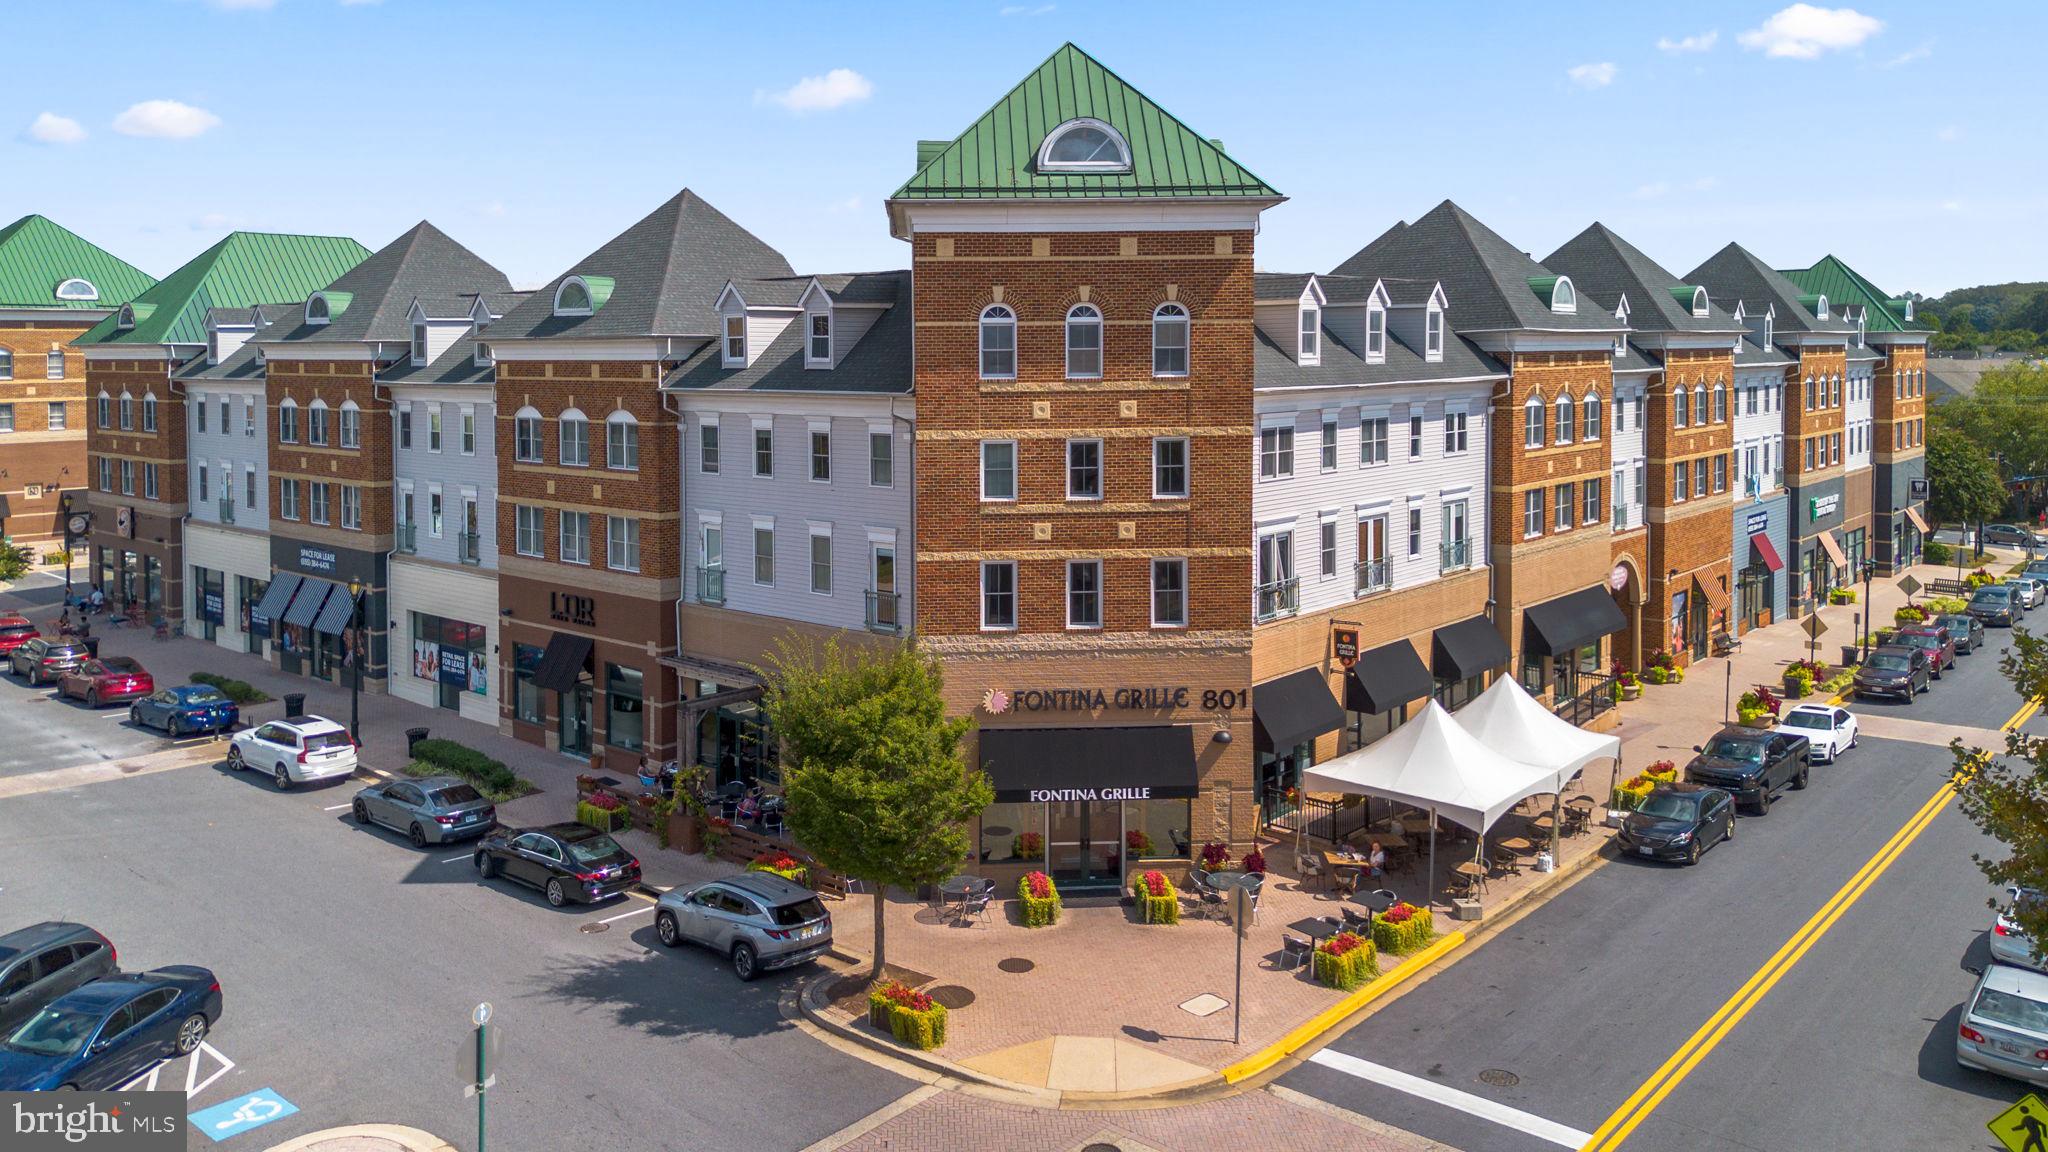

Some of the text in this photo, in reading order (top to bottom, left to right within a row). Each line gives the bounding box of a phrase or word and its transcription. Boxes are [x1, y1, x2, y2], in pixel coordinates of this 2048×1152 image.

[1012, 687, 1189, 712] FONTINA GRILLE
[1203, 688, 1248, 711] 801
[1030, 787, 1151, 802] FONTINA GRILLE
